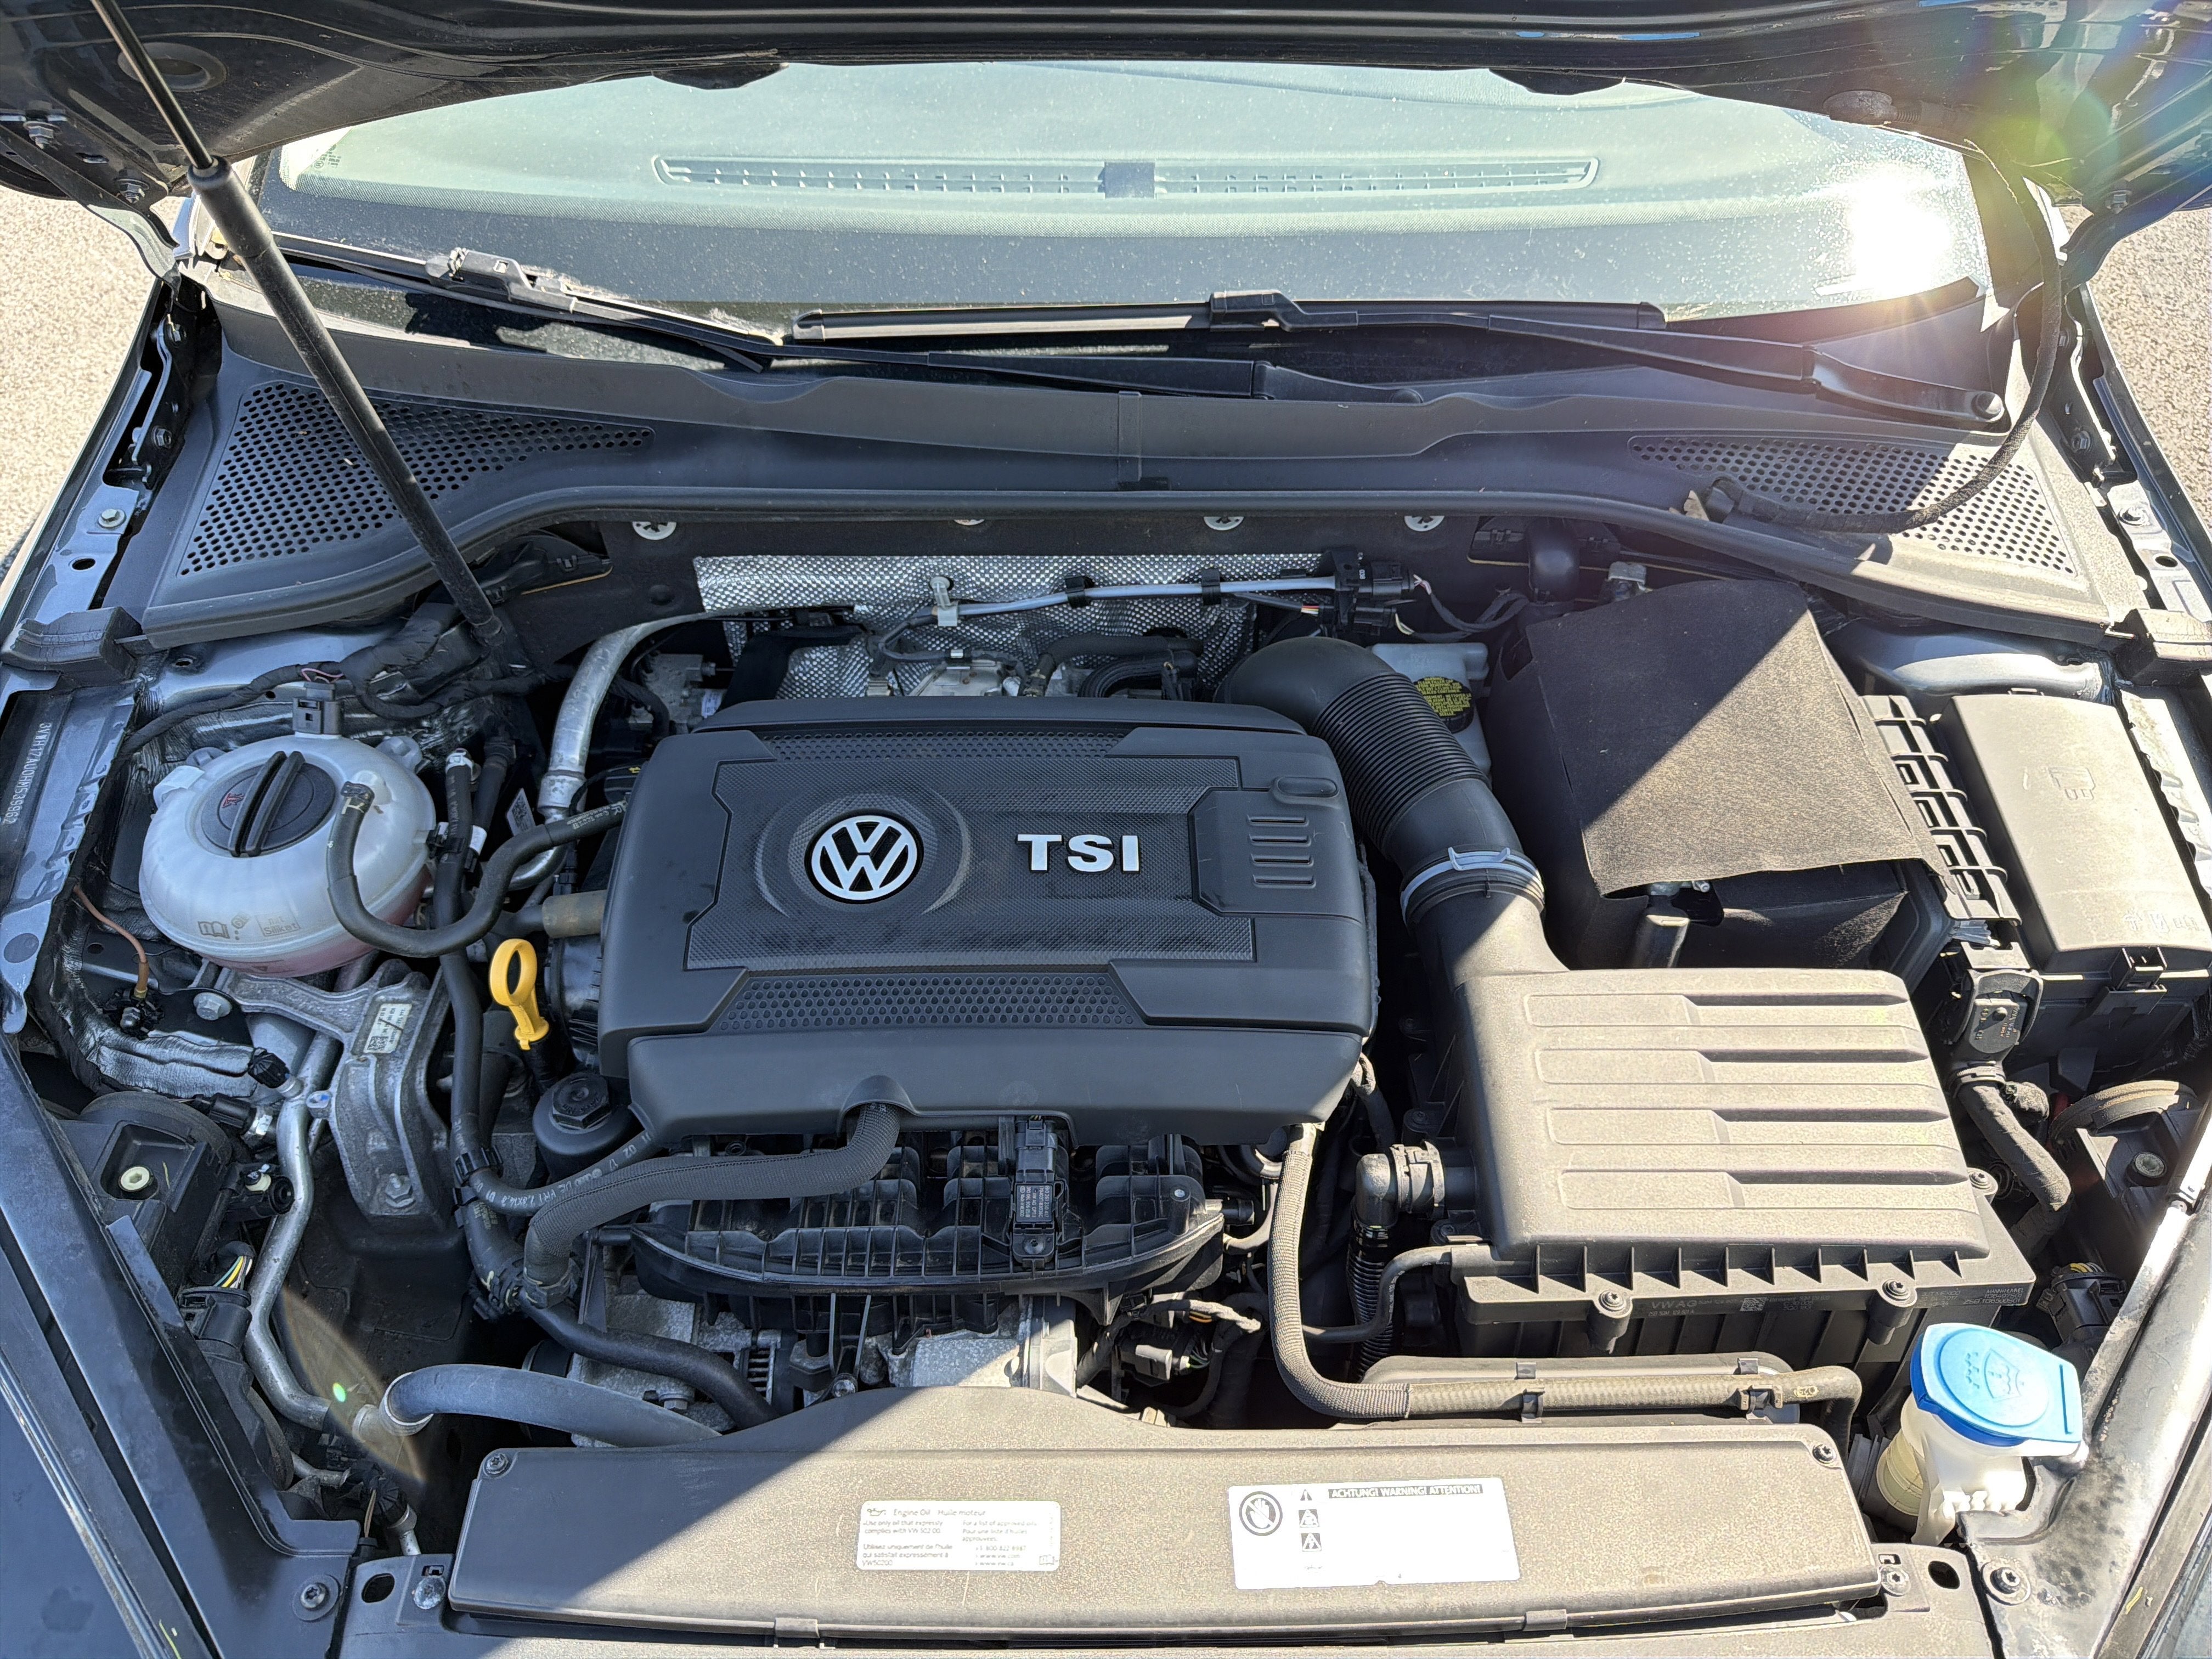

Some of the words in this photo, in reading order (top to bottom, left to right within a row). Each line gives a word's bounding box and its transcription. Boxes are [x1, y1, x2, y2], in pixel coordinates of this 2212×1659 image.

[1017, 833, 1139, 873] TSI
[264, 923, 297, 935] Silikat
[1651, 1300, 1675, 1309] VW
[1675, 1299, 1697, 1308] AG
[1332, 1488, 1379, 1498] ACHTUNG!
[1381, 1486, 1427, 1497] WARNING!
[1429, 1484, 1481, 1496] ATTENTION!
[893, 1509, 918, 1517] Engine
